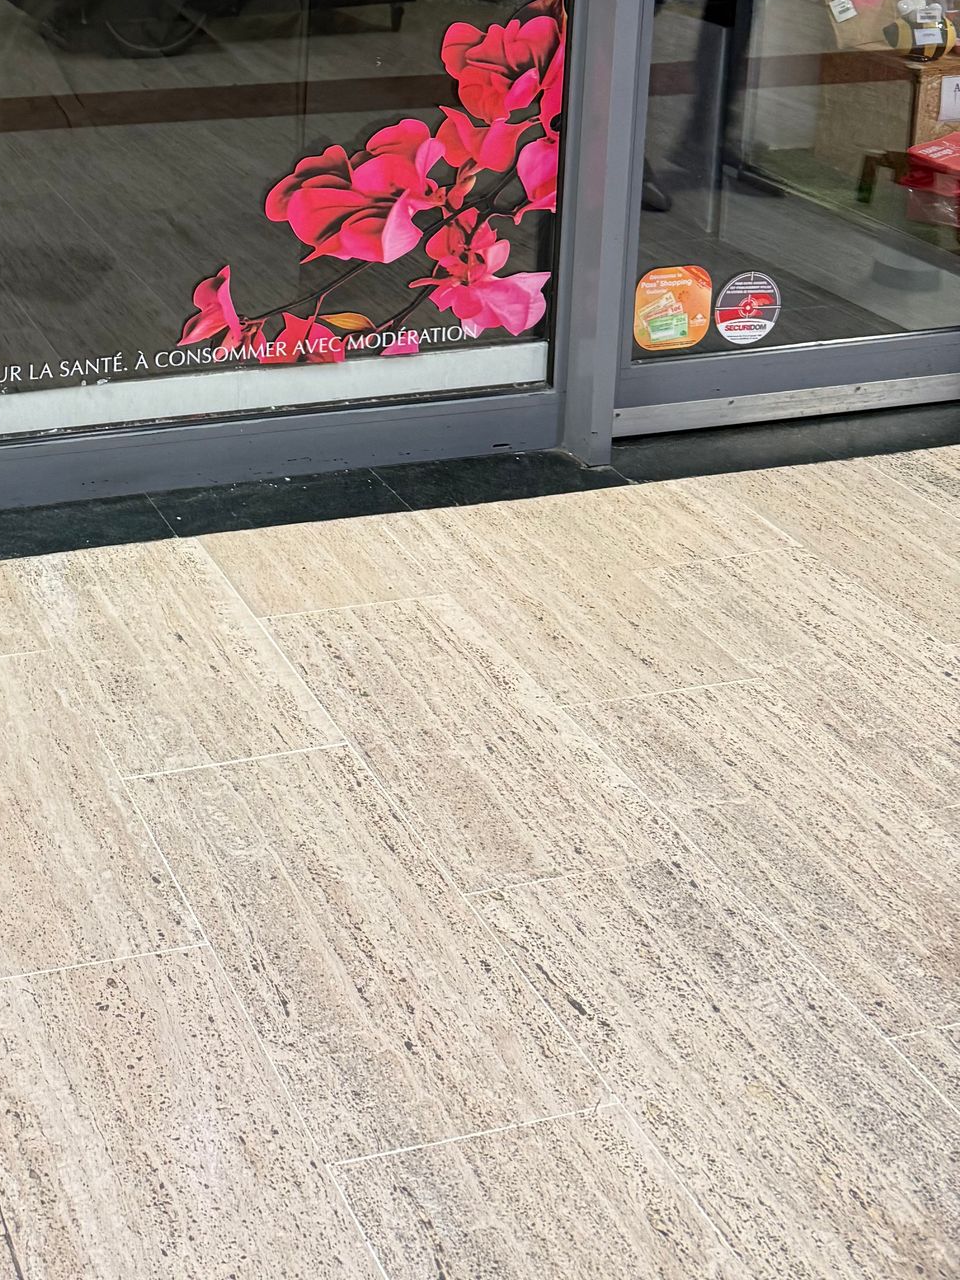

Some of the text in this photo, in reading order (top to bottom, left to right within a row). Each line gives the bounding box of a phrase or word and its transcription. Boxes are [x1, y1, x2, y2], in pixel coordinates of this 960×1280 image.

[660, 279, 692, 287] Shopping
[724, 323, 767, 332] SECURIDOM
[29, 360, 53, 380] LA
[59, 351, 128, 378] SANTÉ.
[135, 350, 149, 370] À
[155, 341, 288, 368] CONSOMMER
[292, 335, 342, 356] AVEC
[347, 324, 478, 350] MODÉRATION
